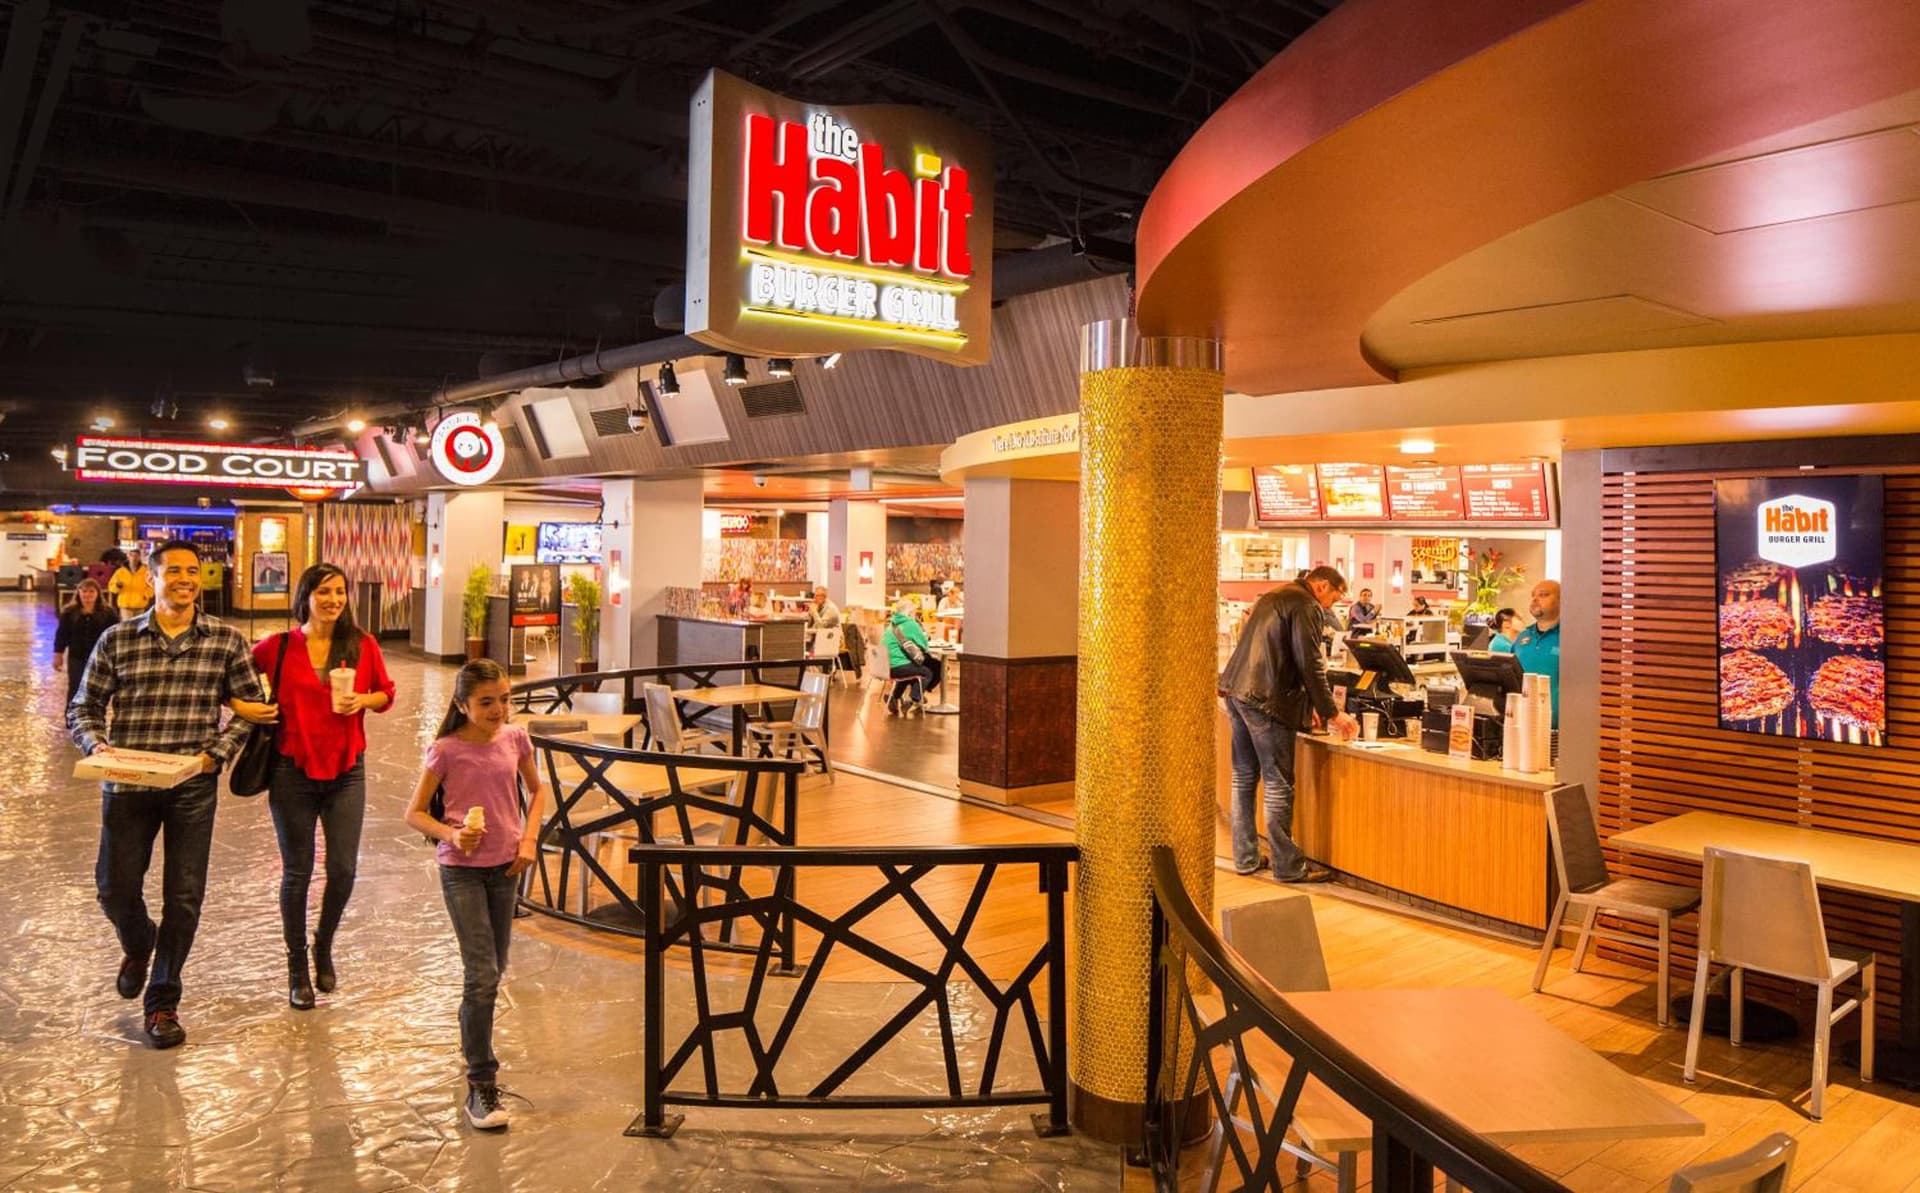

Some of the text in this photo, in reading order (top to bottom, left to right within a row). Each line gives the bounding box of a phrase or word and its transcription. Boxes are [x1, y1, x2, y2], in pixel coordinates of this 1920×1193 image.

[812, 113, 859, 160] the
[744, 113, 973, 278] Habit
[751, 264, 960, 330] BURGER GRILL
[77, 447, 360, 480] FOOD COURT
[1765, 507, 1828, 532] Habit
[1782, 504, 1794, 512] the
[1768, 535, 1826, 544] BURGER GRILL
